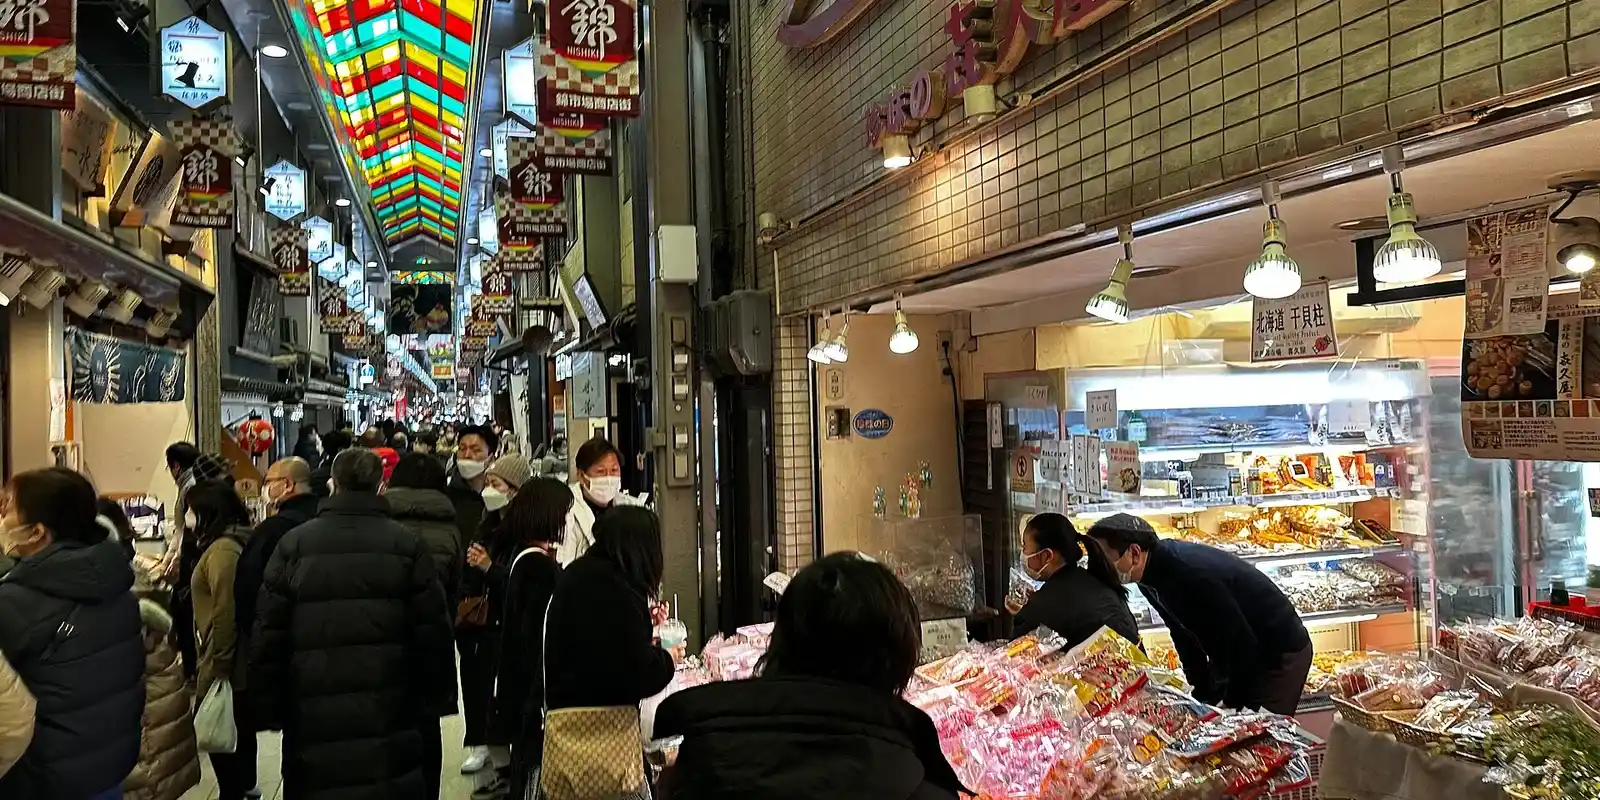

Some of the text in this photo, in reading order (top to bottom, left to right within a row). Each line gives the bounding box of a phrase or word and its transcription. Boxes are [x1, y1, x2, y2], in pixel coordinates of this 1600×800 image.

[561, 0, 618, 61] 錦
[567, 46, 600, 58] NISHIKI
[555, 92, 632, 111] 錦市場商店街
[552, 117, 580, 127] NISHIKI
[183, 149, 220, 194] 錦
[544, 156, 606, 170] 錦市場商店街
[517, 162, 553, 204] 錦
[274, 243, 301, 273] 錦
[485, 272, 507, 296] 錦
[1256, 302, 1326, 334] 北海道 干貝柱
